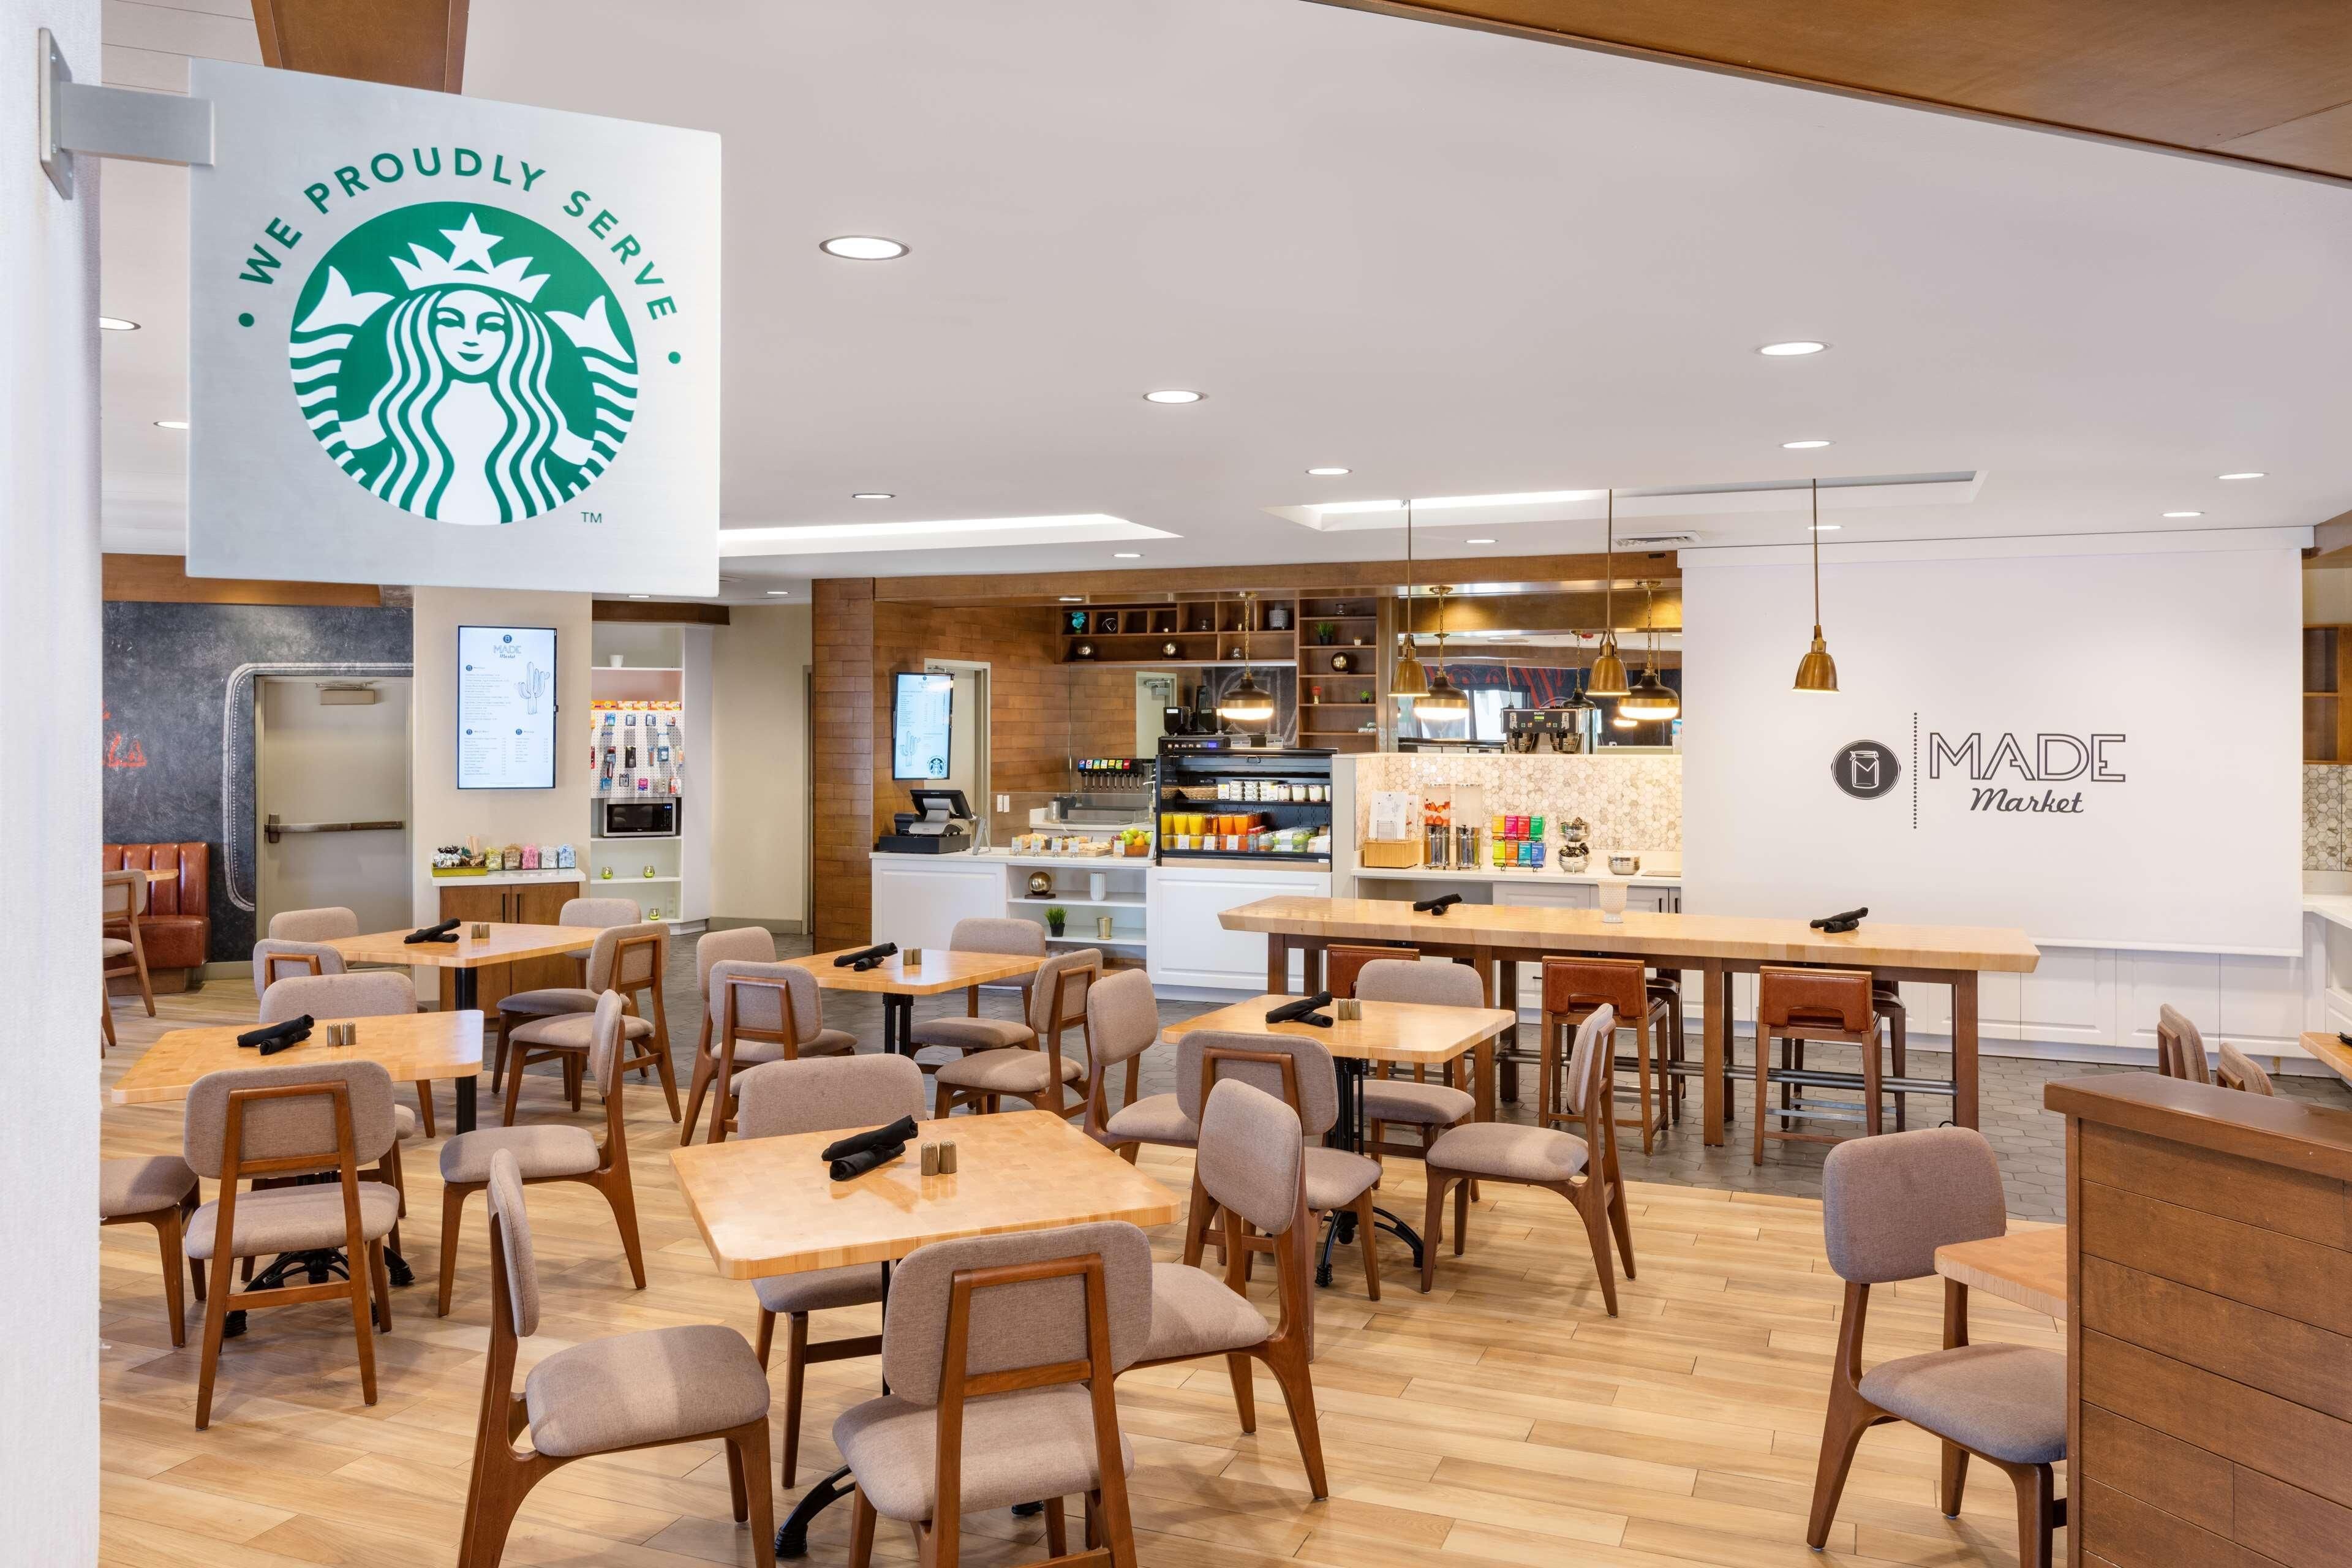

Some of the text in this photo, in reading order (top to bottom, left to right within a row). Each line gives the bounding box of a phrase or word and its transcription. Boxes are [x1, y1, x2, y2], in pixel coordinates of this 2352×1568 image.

[239, 147, 677, 321] WE PROUDLY SERVE
[581, 512, 603, 524] TM
[1929, 732, 2126, 782] MADE
[1970, 788, 2084, 813] Market
